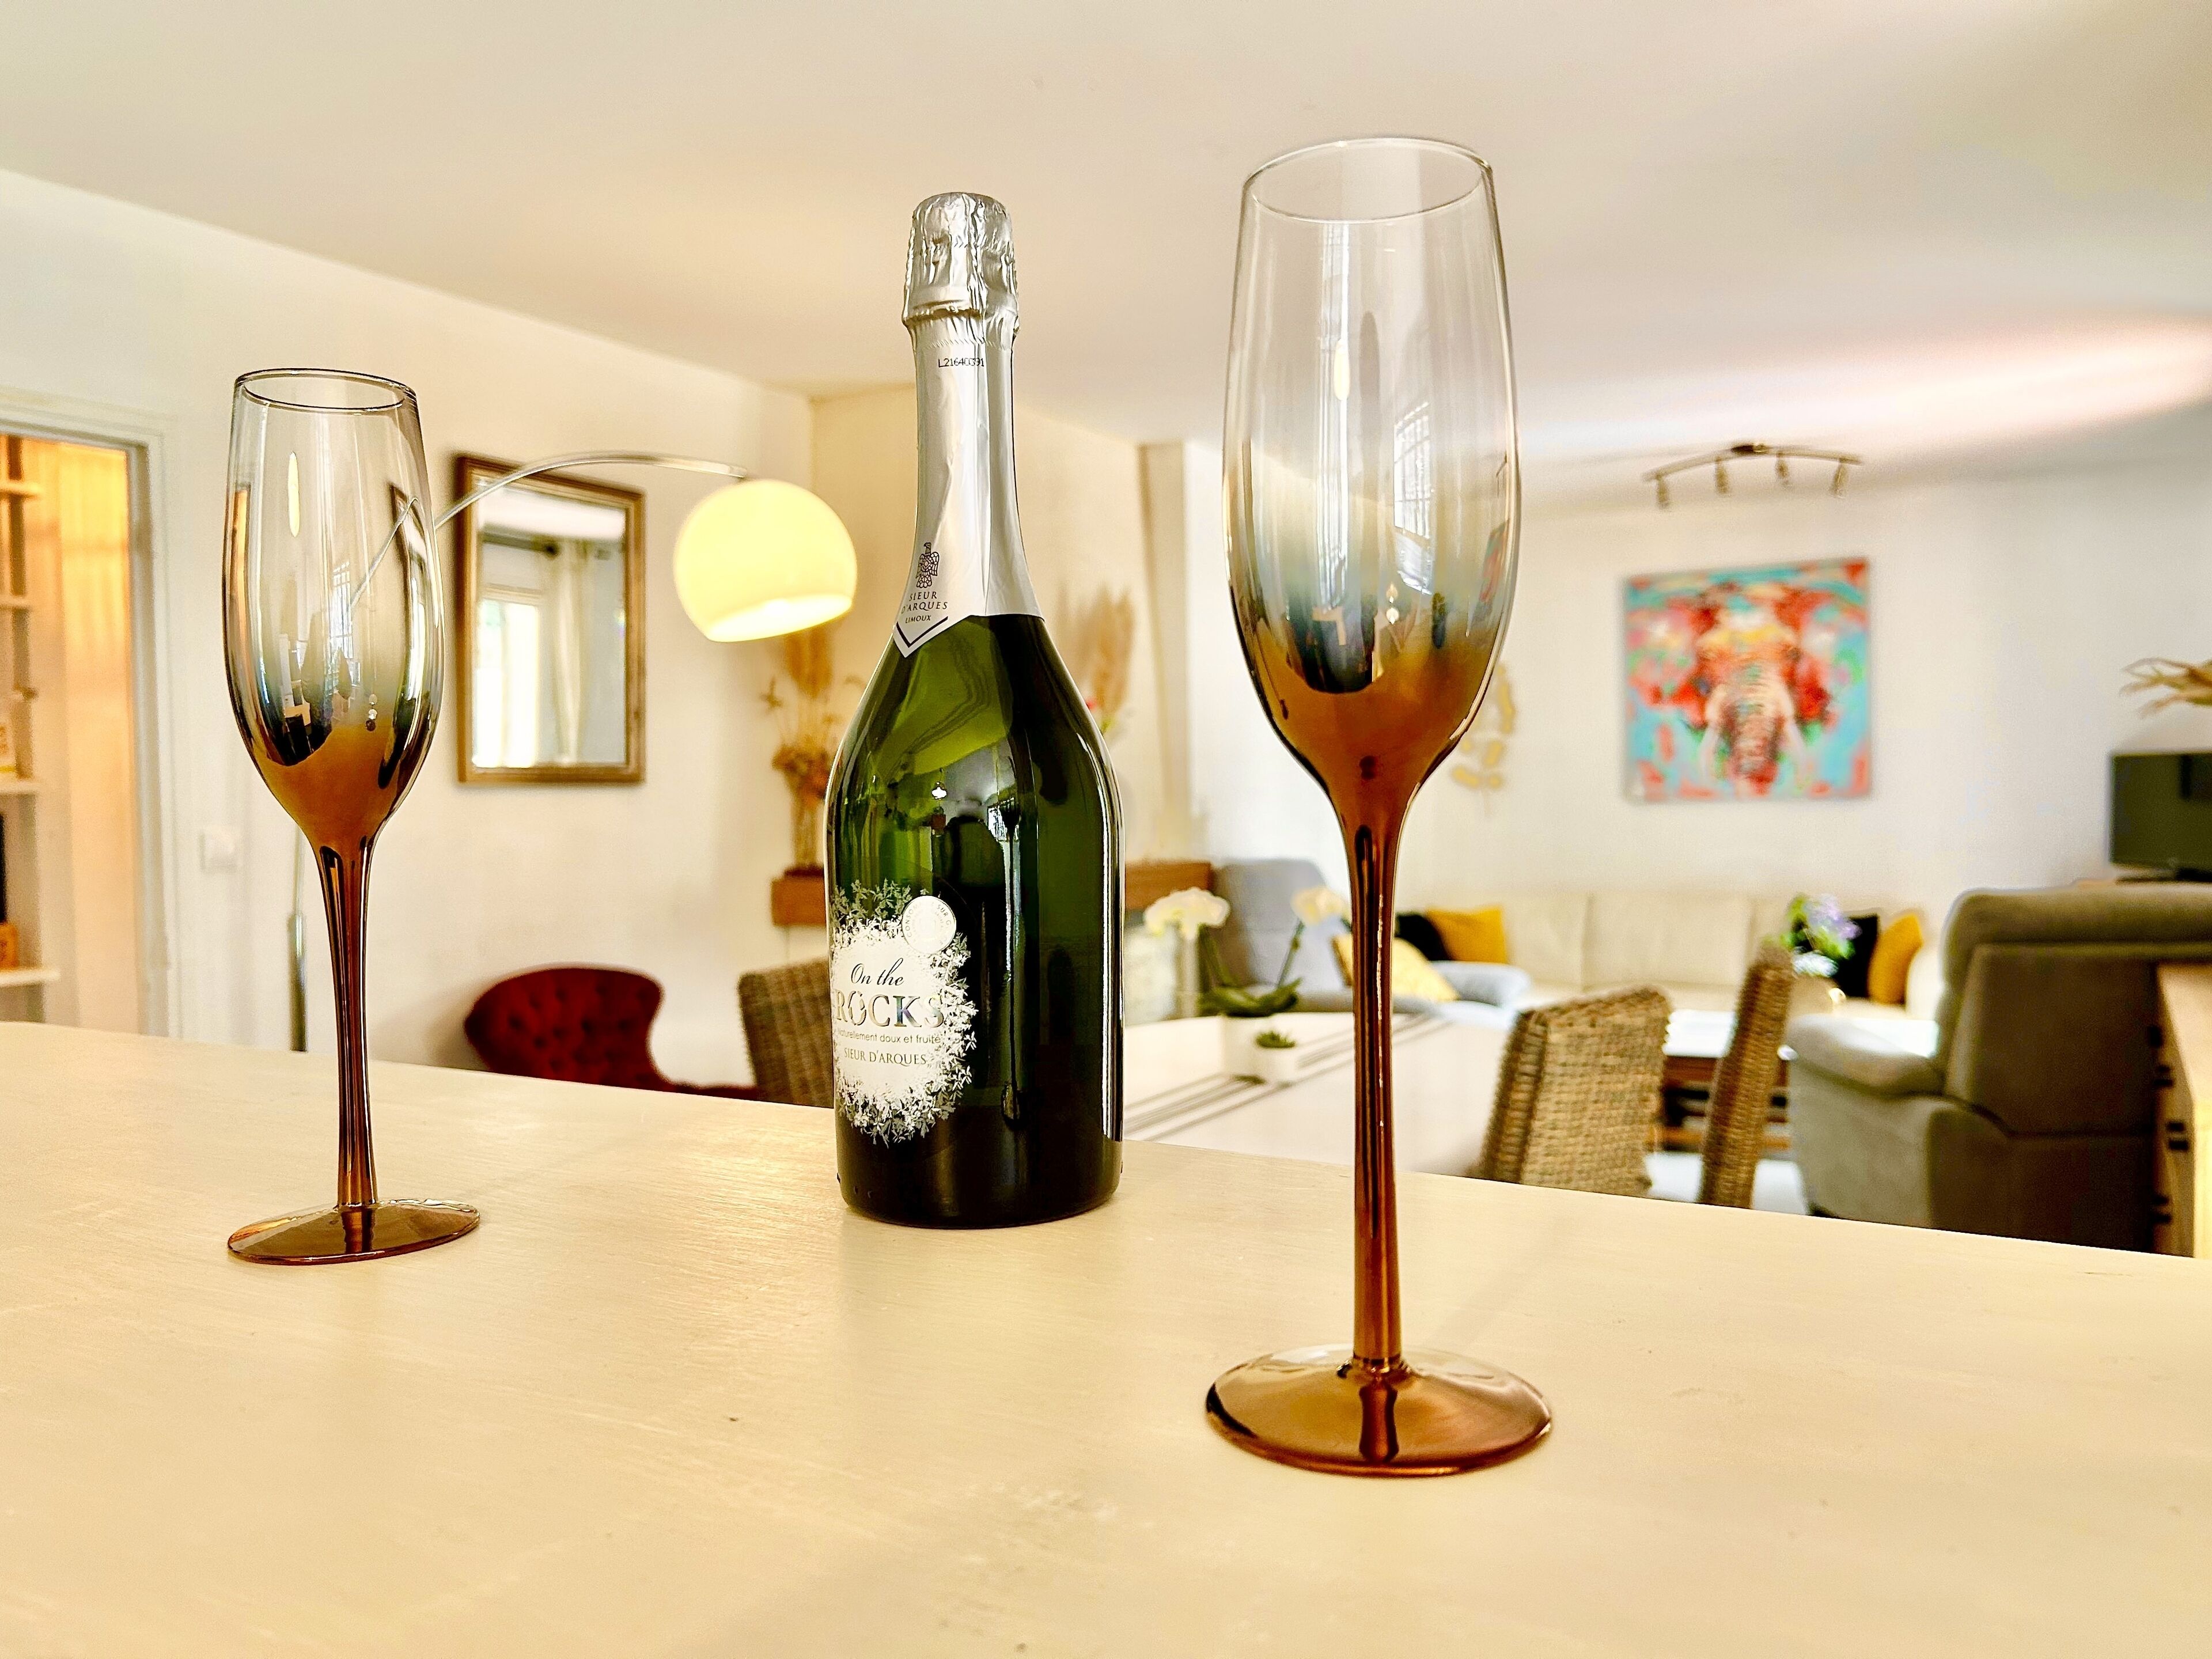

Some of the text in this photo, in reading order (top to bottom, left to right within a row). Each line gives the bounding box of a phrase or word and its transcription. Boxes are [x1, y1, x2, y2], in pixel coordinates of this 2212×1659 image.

[909, 591, 937, 601] SIEUR
[901, 601, 948, 614] D'ARQUES
[905, 615, 931, 623] LIMOUX
[937, 904, 949, 917] SUR
[851, 957, 905, 986] On the
[835, 988, 945, 1028] ROCKS
[880, 1034, 900, 1043] doux
[903, 1035, 912, 1043] et
[844, 1047, 927, 1067] SIEUR D'ARQUES
